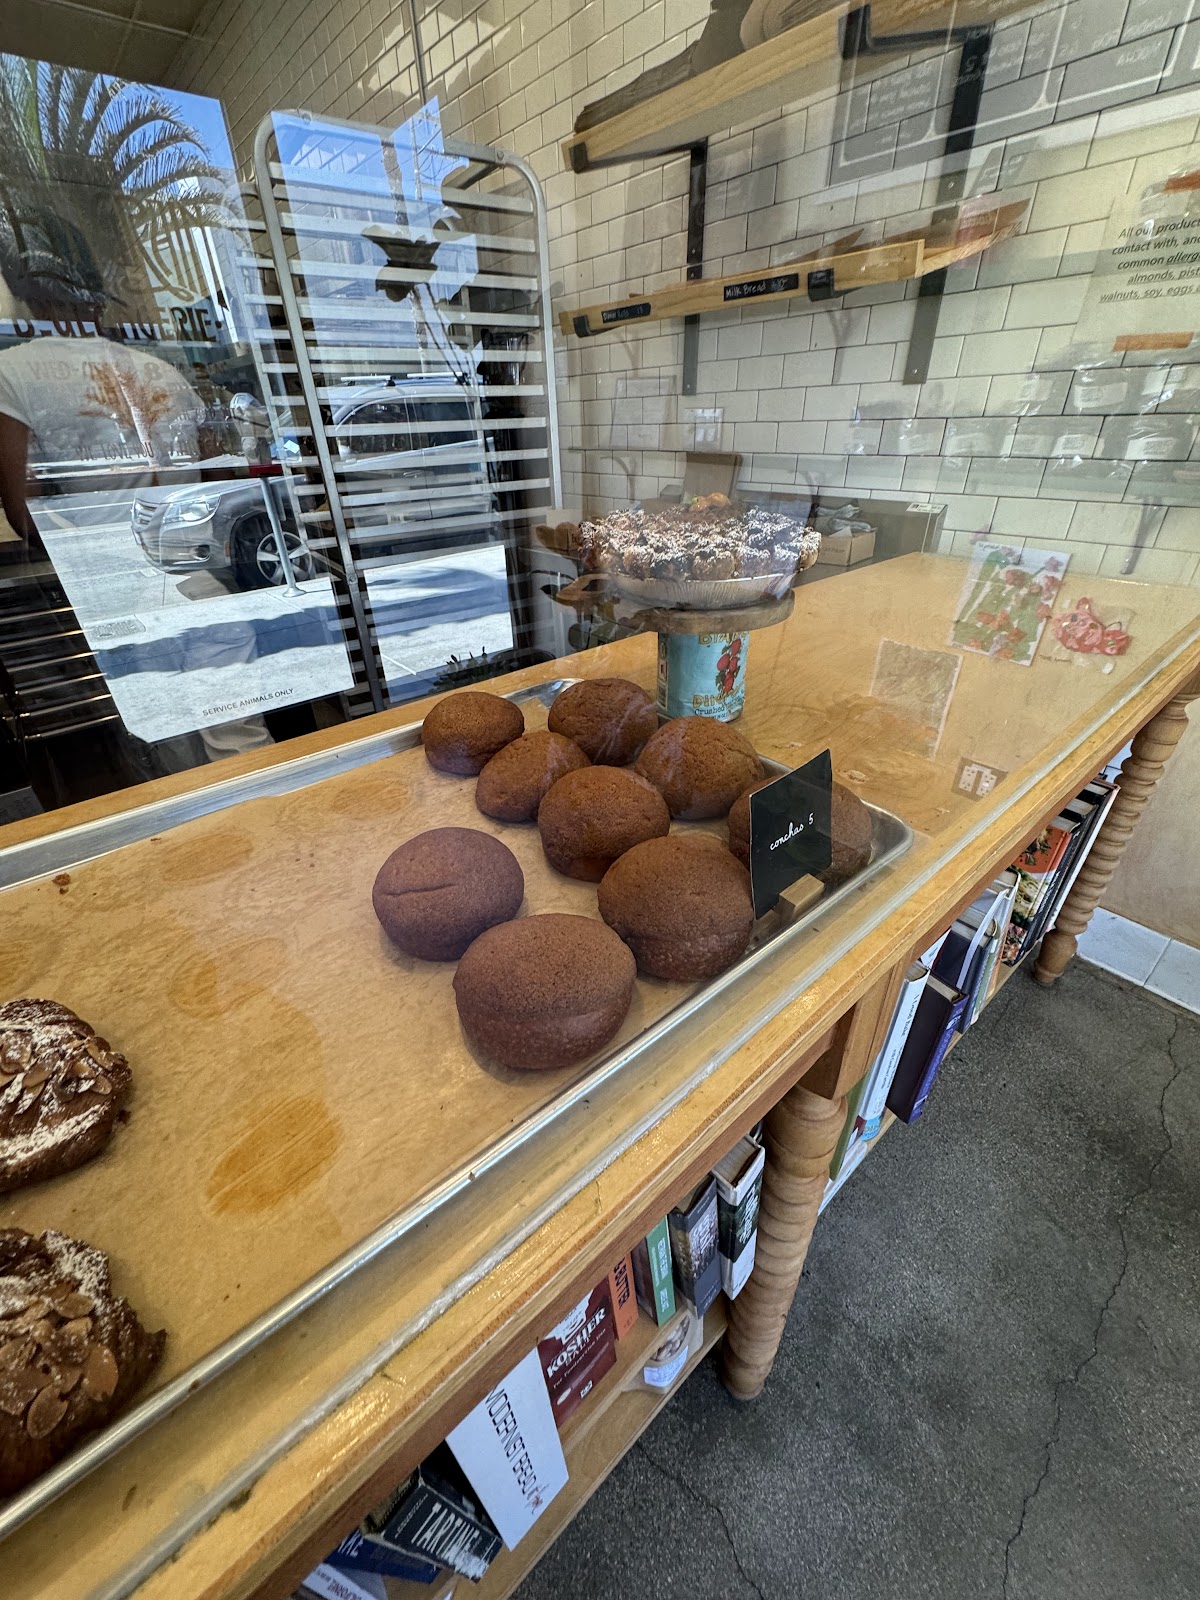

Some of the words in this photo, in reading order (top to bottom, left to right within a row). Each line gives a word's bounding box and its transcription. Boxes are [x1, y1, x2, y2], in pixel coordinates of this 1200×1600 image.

[1118, 227, 1133, 240] All
[1111, 241, 1151, 256] contact
[1153, 237, 1179, 251] with,
[1117, 257, 1169, 270] common
[1127, 269, 1175, 285] almonds,
[1177, 266, 1200, 282] pist
[724, 285, 743, 299] Milk
[743, 281, 767, 296] Bread
[1099, 287, 1141, 302] walnuts,
[1144, 286, 1163, 299] soy,
[1166, 284, 1195, 298] eggs
[202, 702, 238, 716] SERVICE
[239, 693, 274, 707] ANIMALS
[274, 687, 294, 698] ONLY
[769, 821, 804, 851] conchas
[808, 812, 814, 825] 5
[546, 1306, 607, 1379] KOSHER
[512, 1451, 537, 1496] BREAD
[410, 1501, 481, 1564] TARTINE
